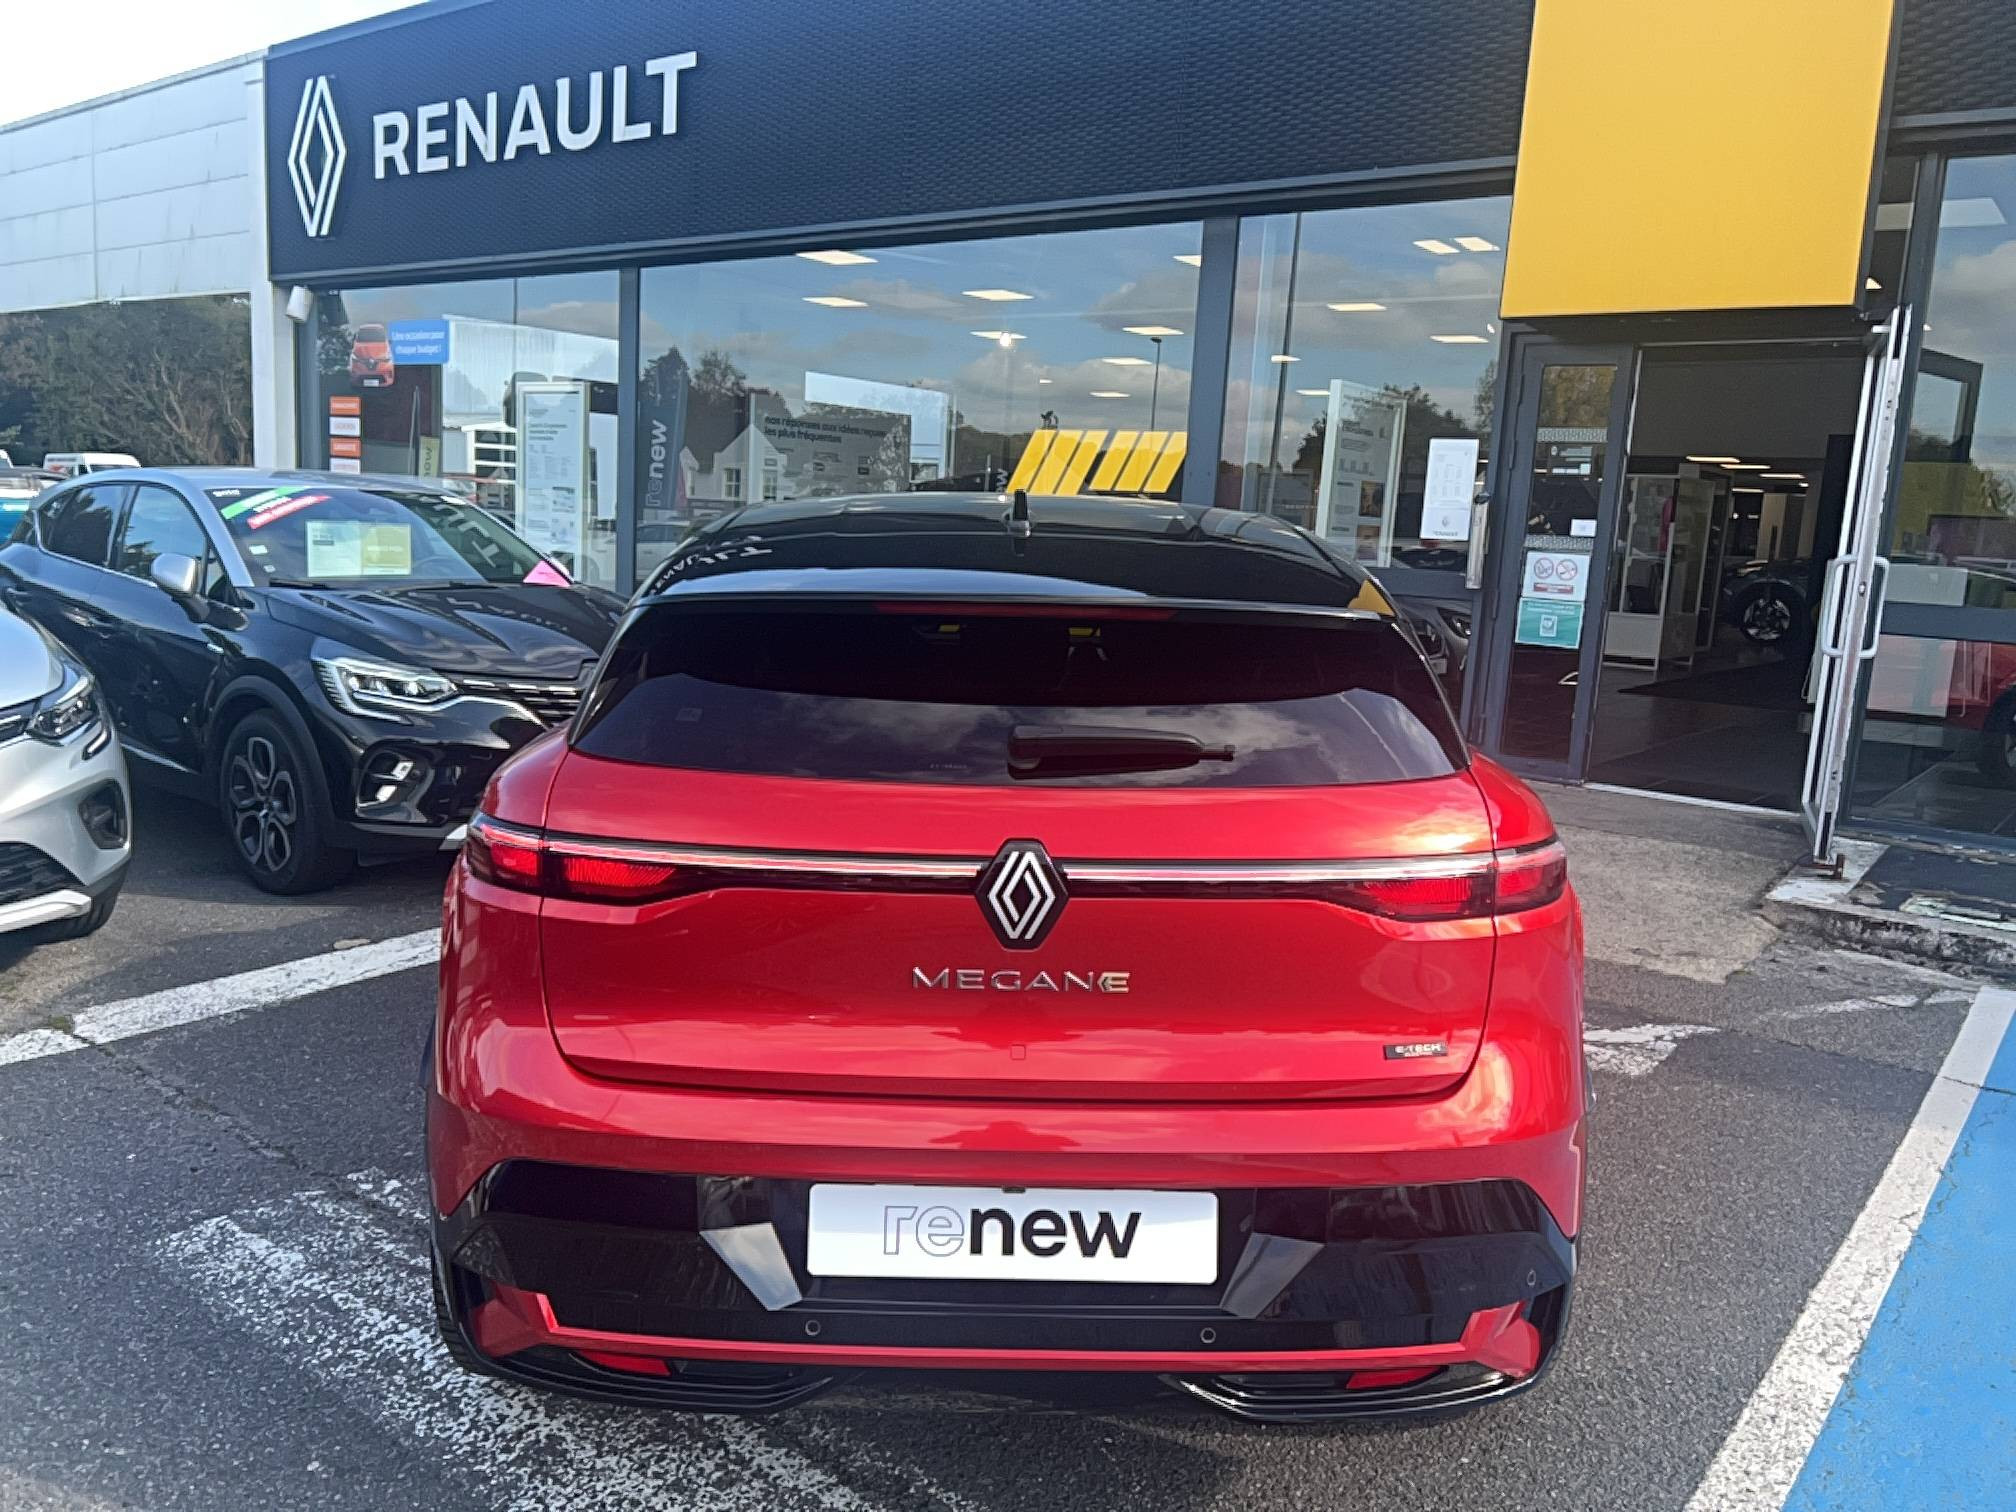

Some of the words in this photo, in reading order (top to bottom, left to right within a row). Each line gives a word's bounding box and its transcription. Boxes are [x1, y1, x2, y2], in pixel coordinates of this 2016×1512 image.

[372, 50, 697, 180] RENAULT
[646, 419, 667, 507] renew
[912, 966, 1131, 993] MEGANE
[883, 1204, 1142, 1259] renew
